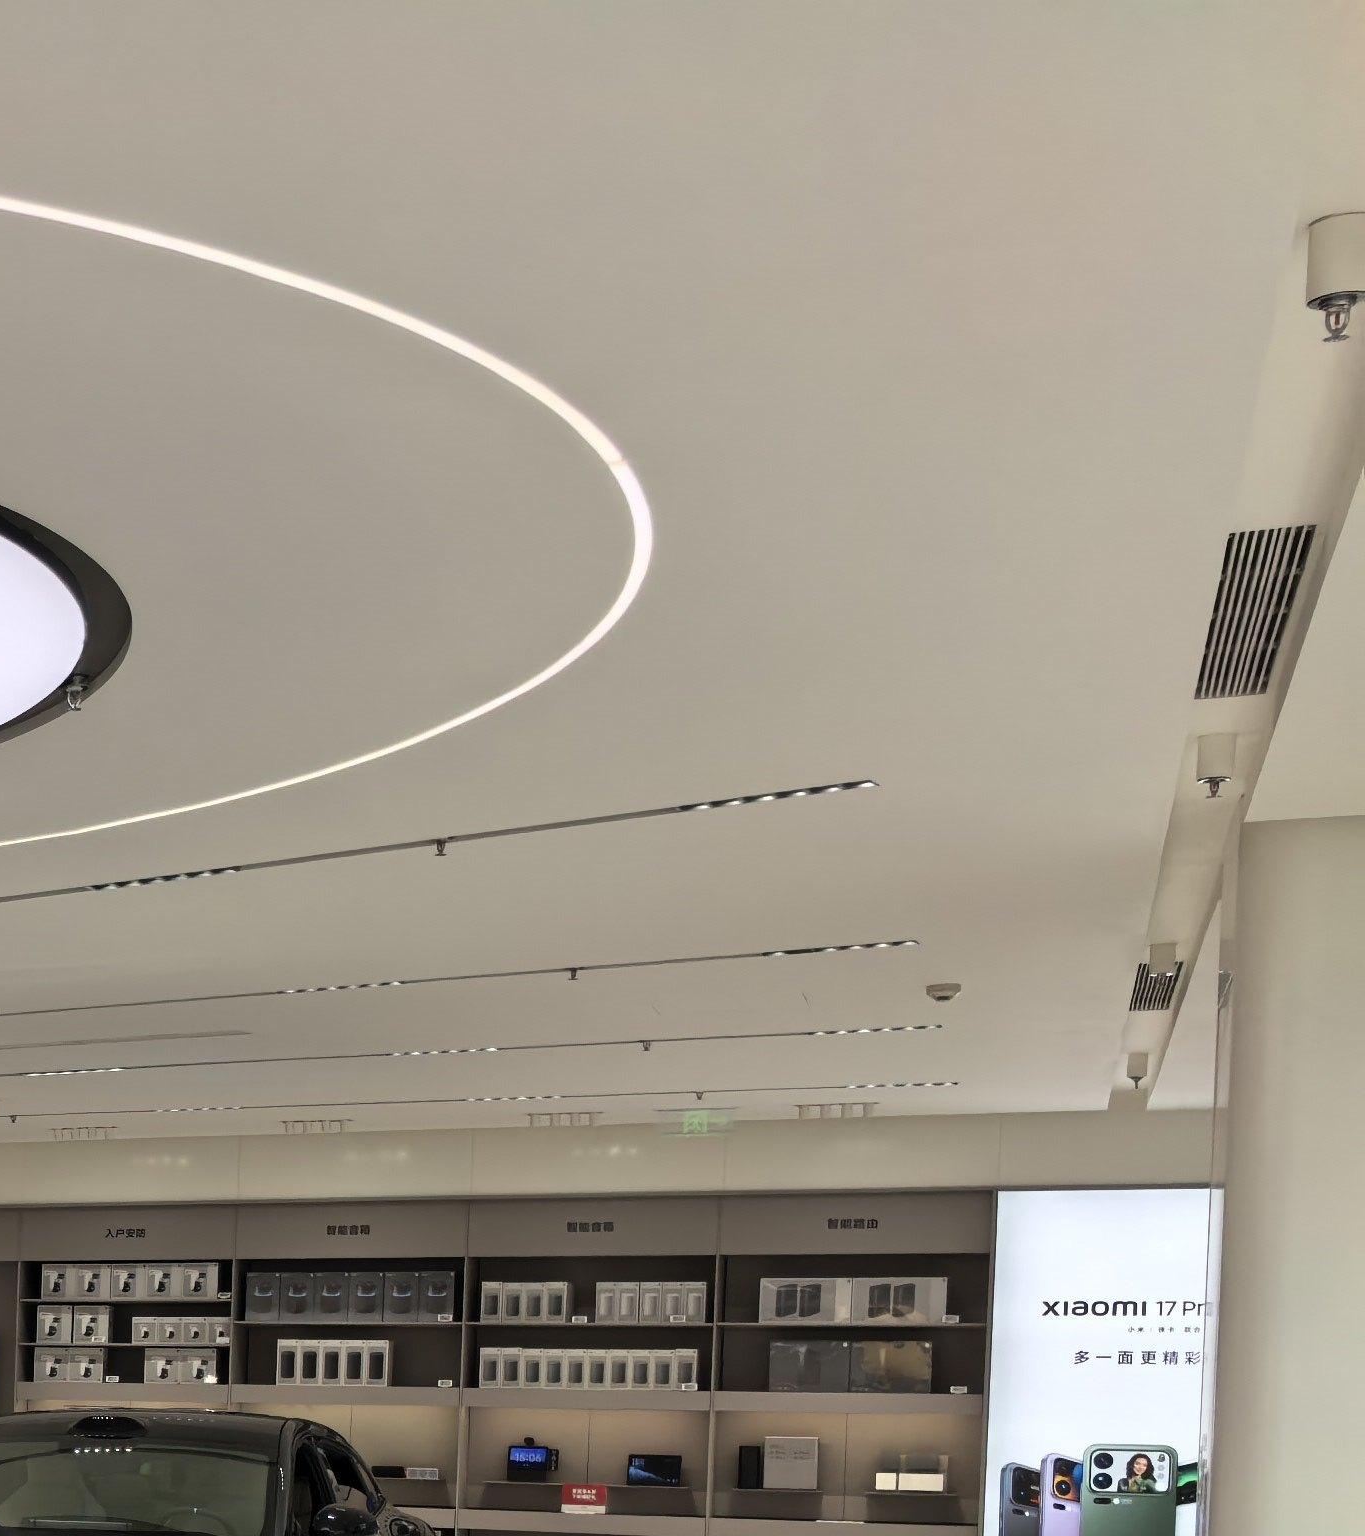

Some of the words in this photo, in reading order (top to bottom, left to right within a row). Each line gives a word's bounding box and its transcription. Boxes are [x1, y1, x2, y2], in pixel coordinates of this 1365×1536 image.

[105, 1228, 146, 1239] 入户安防
[1156, 1300, 1177, 1317] 17
[1074, 1350, 1201, 1365] 多一面更精彩
